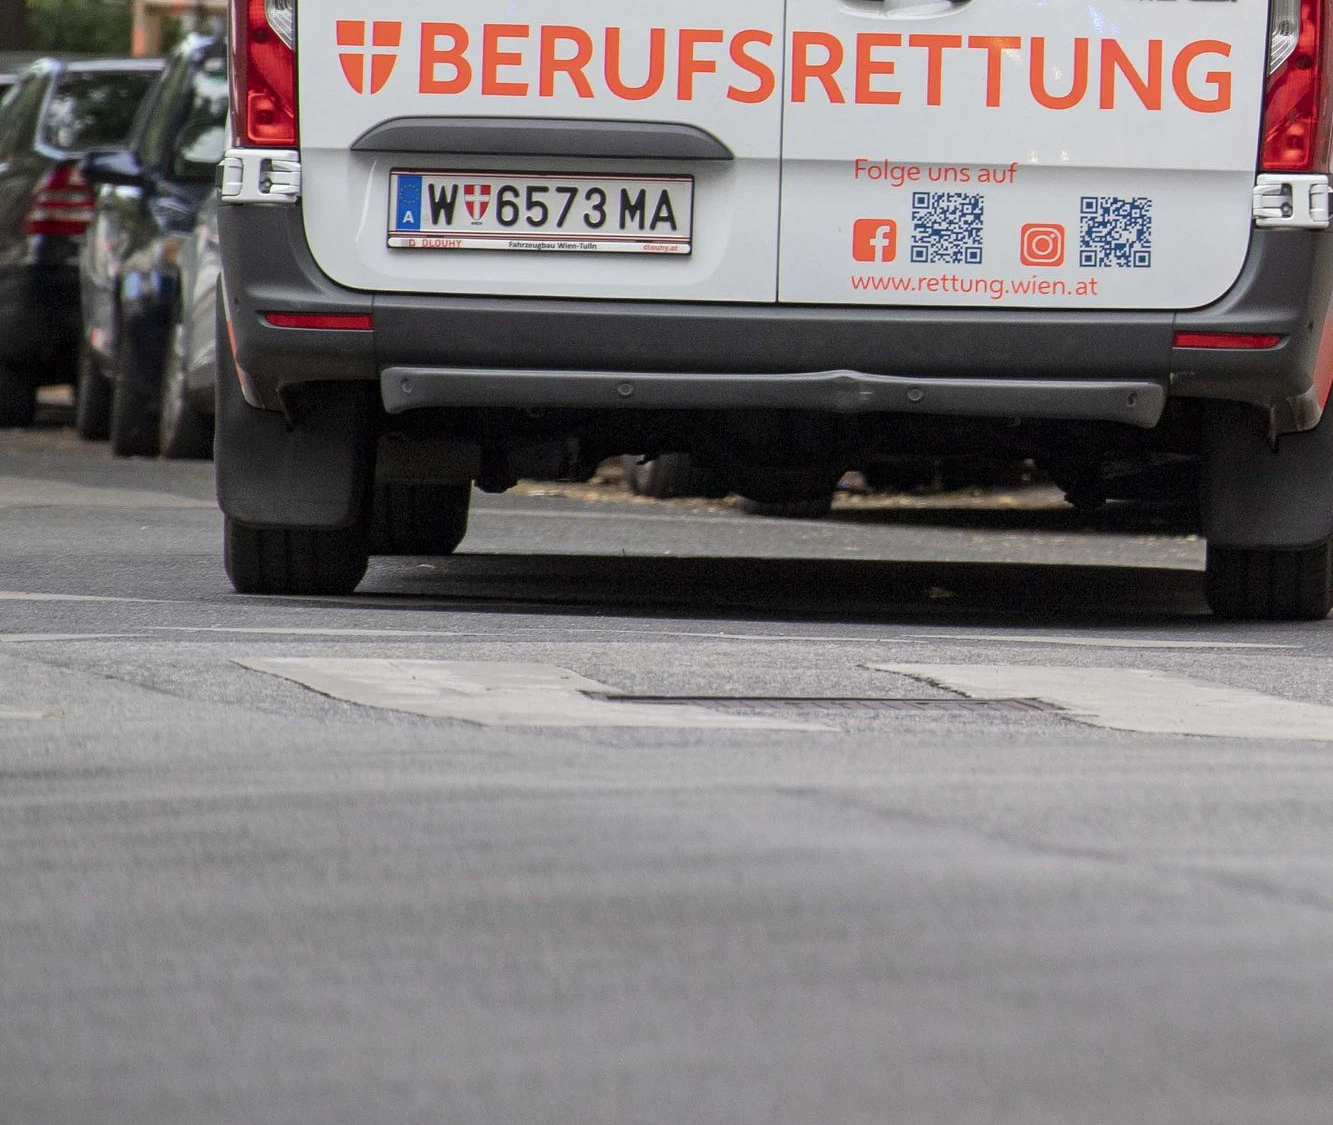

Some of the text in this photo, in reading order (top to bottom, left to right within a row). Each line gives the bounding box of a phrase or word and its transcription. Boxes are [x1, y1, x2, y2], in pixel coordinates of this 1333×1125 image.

[418, 22, 1232, 113] BERUFSRETTUNG
[853, 158, 1018, 187] Folge uns auf
[427, 183, 459, 226] W
[495, 184, 607, 229] 6573
[619, 188, 678, 231] MA
[422, 239, 462, 248] DLOUHY
[508, 241, 556, 251] Fahrzeugbau
[851, 274, 1098, 301] www.rettung.wien.at
